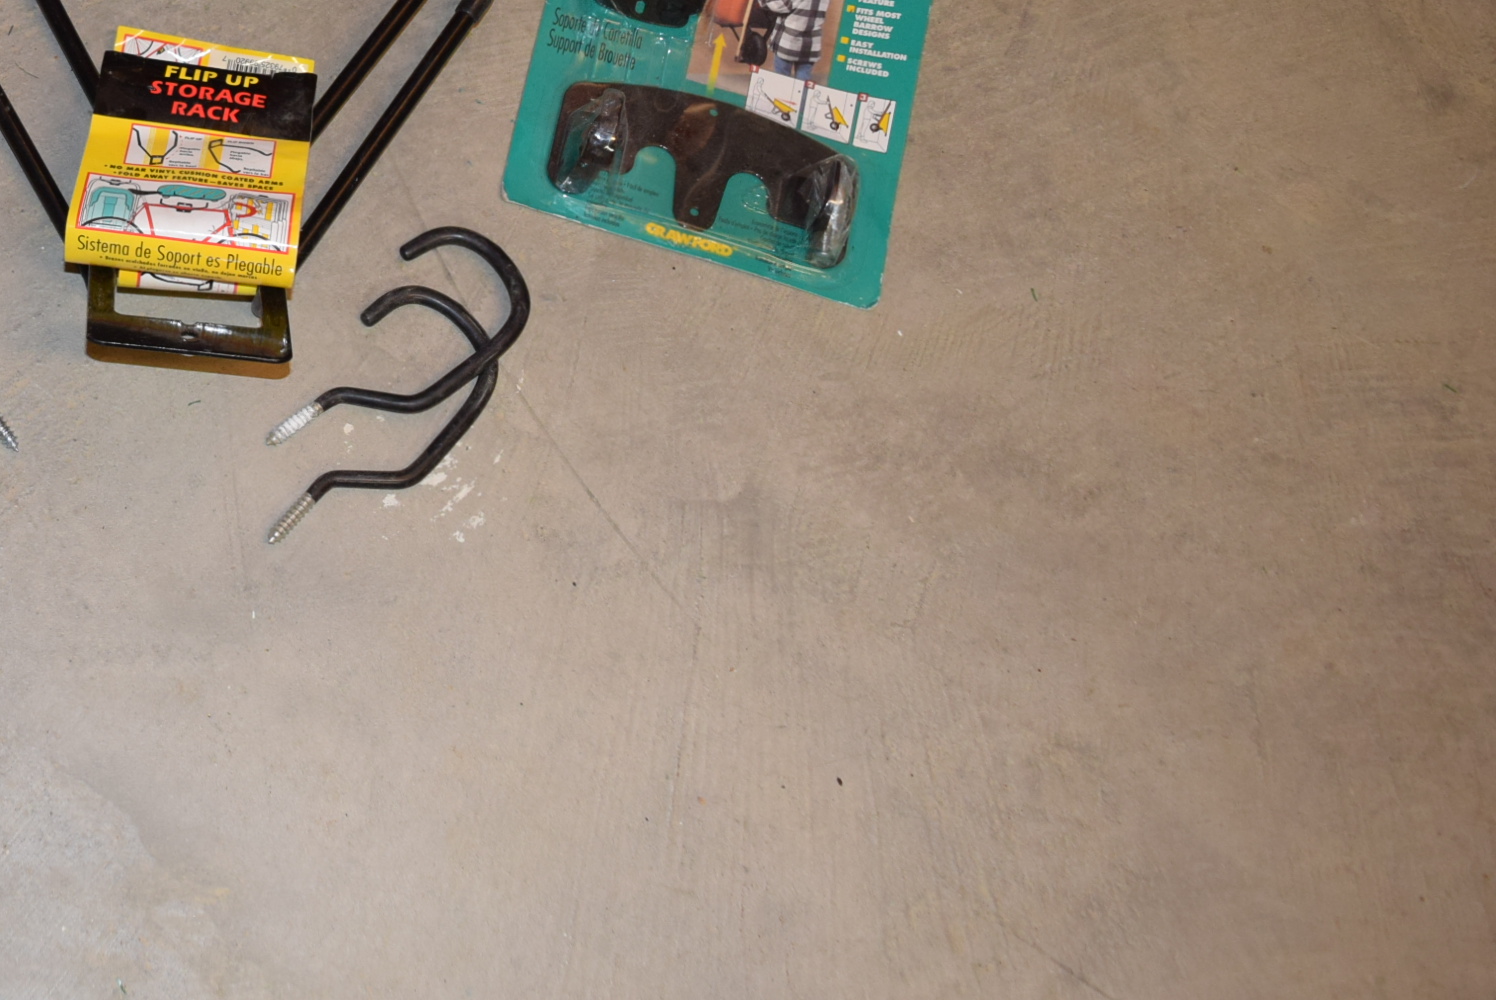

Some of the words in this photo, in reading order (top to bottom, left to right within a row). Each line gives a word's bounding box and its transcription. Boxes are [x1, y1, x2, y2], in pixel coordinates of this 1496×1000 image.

[553, 7, 586, 33] Soporte
[855, 14, 884, 24] WHEEL
[856, 7, 874, 16] FITS
[875, 10, 902, 20] MOST
[853, 21, 893, 32] BARROW
[852, 28, 890, 39] DESIGNS
[547, 28, 582, 55] Support
[584, 41, 596, 58] de
[598, 42, 636, 70] Brouette
[850, 40, 874, 49] EASY
[849, 47, 907, 61] INSTALLATION
[847, 58, 882, 69] SCREWS
[164, 65, 218, 85] FLIP
[225, 73, 260, 88] UP
[846, 64, 889, 77] INCLUDED
[150, 80, 268, 108] STORAGE
[170, 101, 240, 123] RACK
[178, 170, 218, 179] CUSHION
[221, 174, 255, 183] COATED
[247, 183, 274, 191] SPACE
[77, 235, 130, 256] Sistema
[135, 242, 152, 259] de
[157, 245, 202, 269] Soport
[206, 255, 220, 268] es
[226, 254, 283, 278] Plegable
